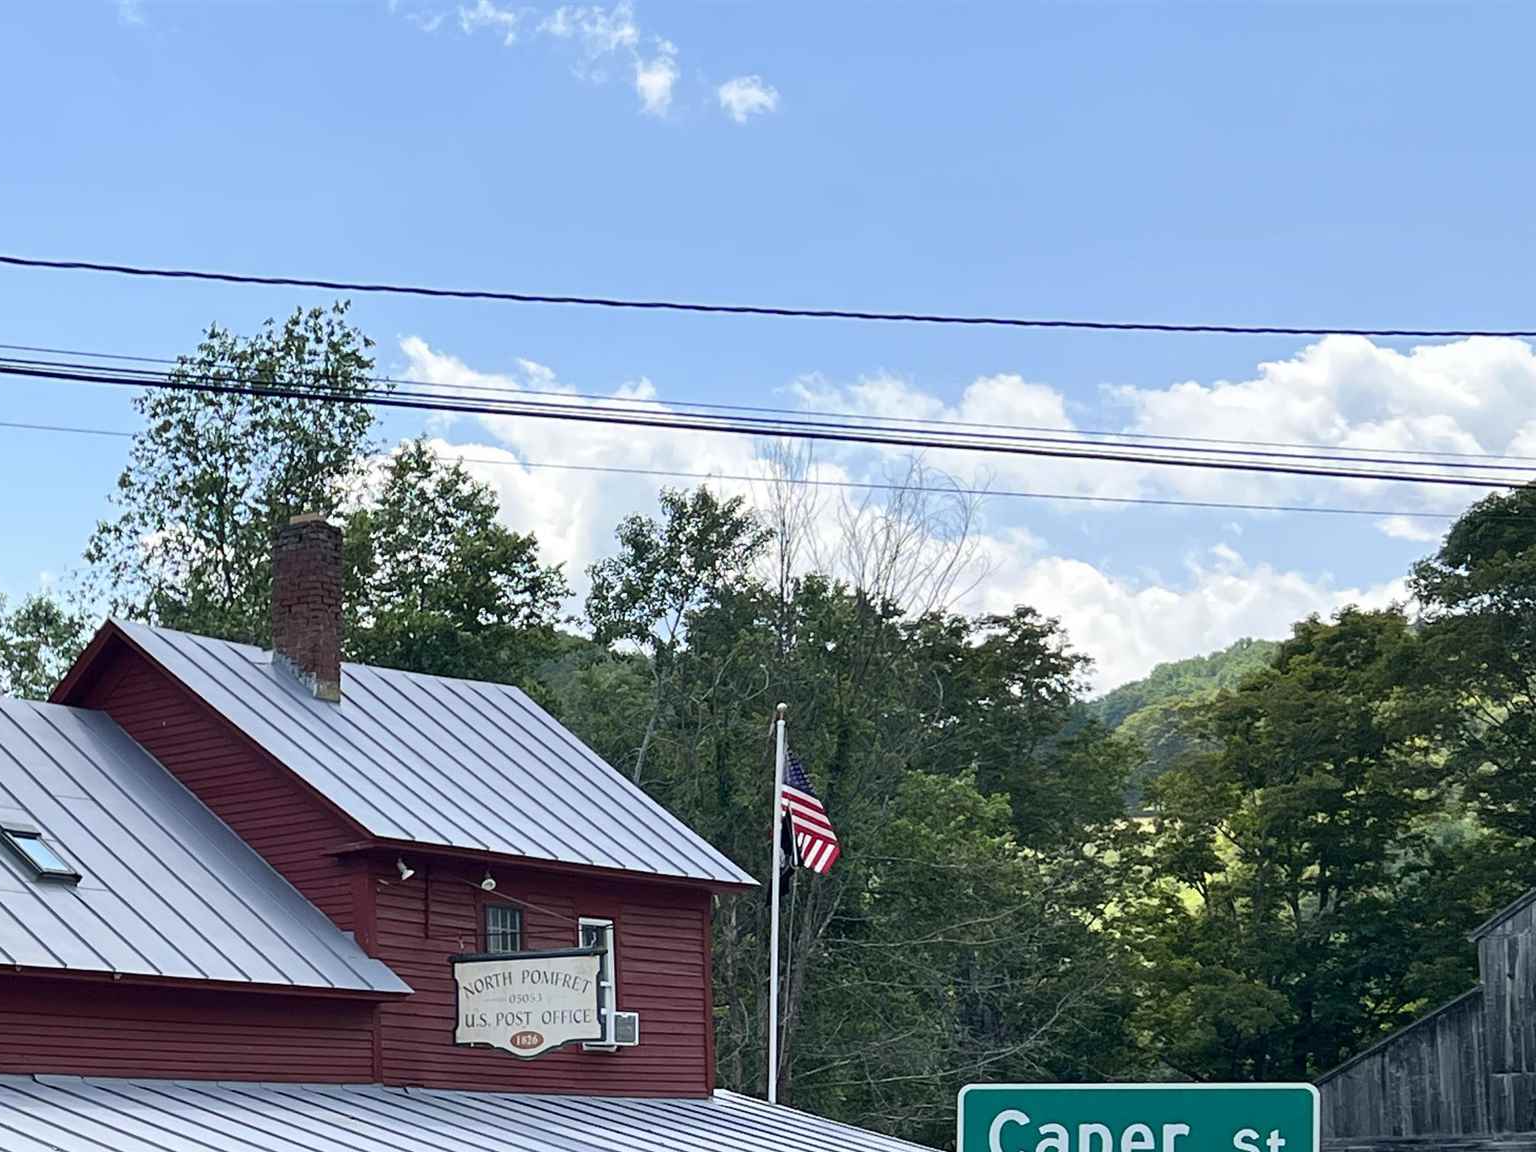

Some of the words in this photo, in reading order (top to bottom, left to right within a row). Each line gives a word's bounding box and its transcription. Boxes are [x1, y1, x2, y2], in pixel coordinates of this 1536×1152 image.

[463, 970, 513, 999] NORTH
[521, 969, 592, 994] POMFRET
[465, 1013, 491, 1028] U.S.
[496, 1010, 532, 1026] POST
[541, 1008, 592, 1024] OFFICE
